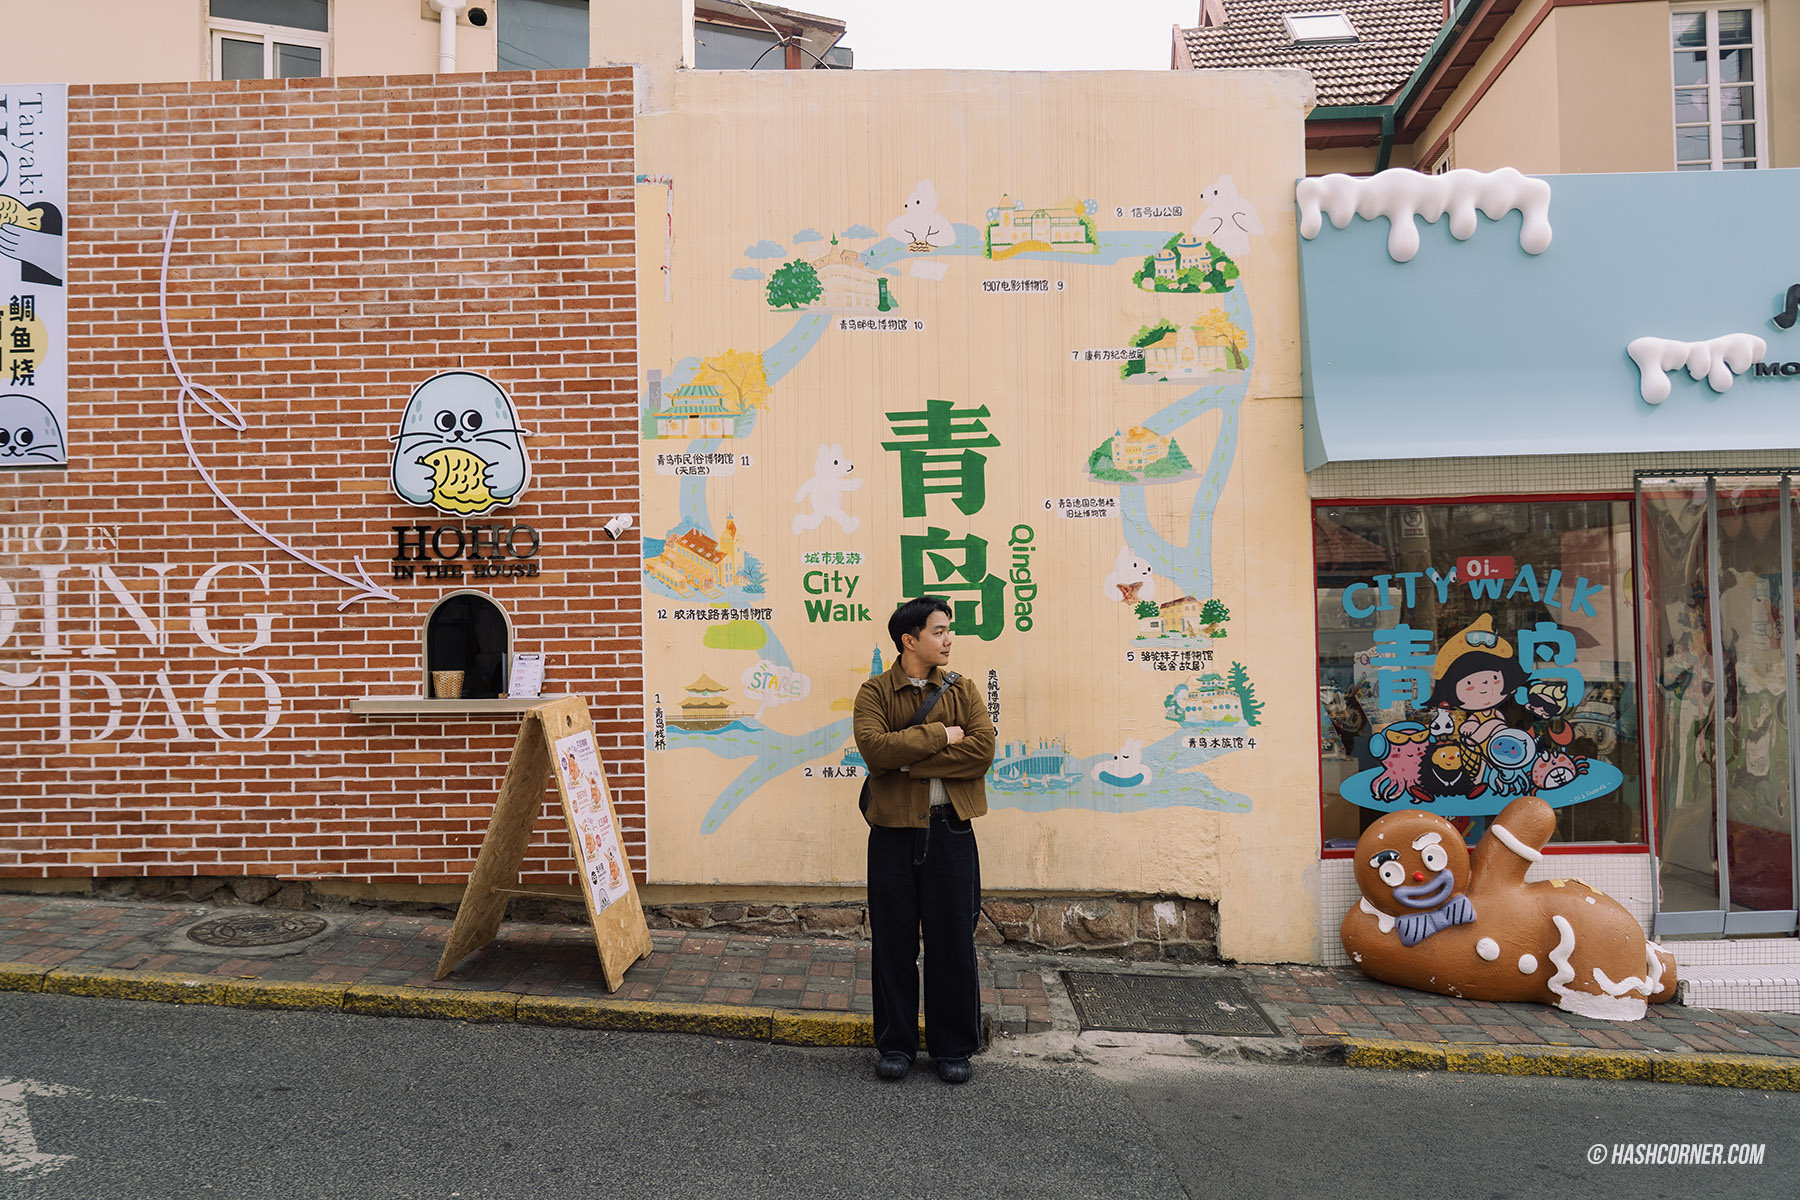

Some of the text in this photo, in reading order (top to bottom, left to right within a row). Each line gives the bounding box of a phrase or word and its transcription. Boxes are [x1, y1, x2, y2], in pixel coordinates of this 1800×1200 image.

[11, 92, 43, 195] Taiyaki
[1116, 206, 1182, 217] 8 信号山公园
[1057, 281, 1064, 290] 9
[914, 321, 923, 330] 10
[9, 294, 35, 386] 鲷鱼烧
[1072, 351, 1079, 360] 7
[741, 456, 750, 466] 11
[1045, 500, 1052, 509] 6
[880, 399, 1007, 641] 青岛
[84, 526, 122, 550] IN
[392, 524, 540, 561] HOHO
[804, 551, 862, 565] 城市漫游
[393, 563, 540, 579] IN THE HOUSE
[1008, 524, 1037, 632] QingDao
[803, 570, 860, 598] City
[1342, 563, 1603, 619] CITY WALK
[657, 609, 667, 619] 12
[804, 599, 872, 623] Walk
[1127, 651, 1135, 661] 5
[47, 667, 282, 742] DAO
[655, 693, 661, 704] 1
[1248, 738, 1256, 749] 4
[804, 766, 857, 778] 2 情人坝
